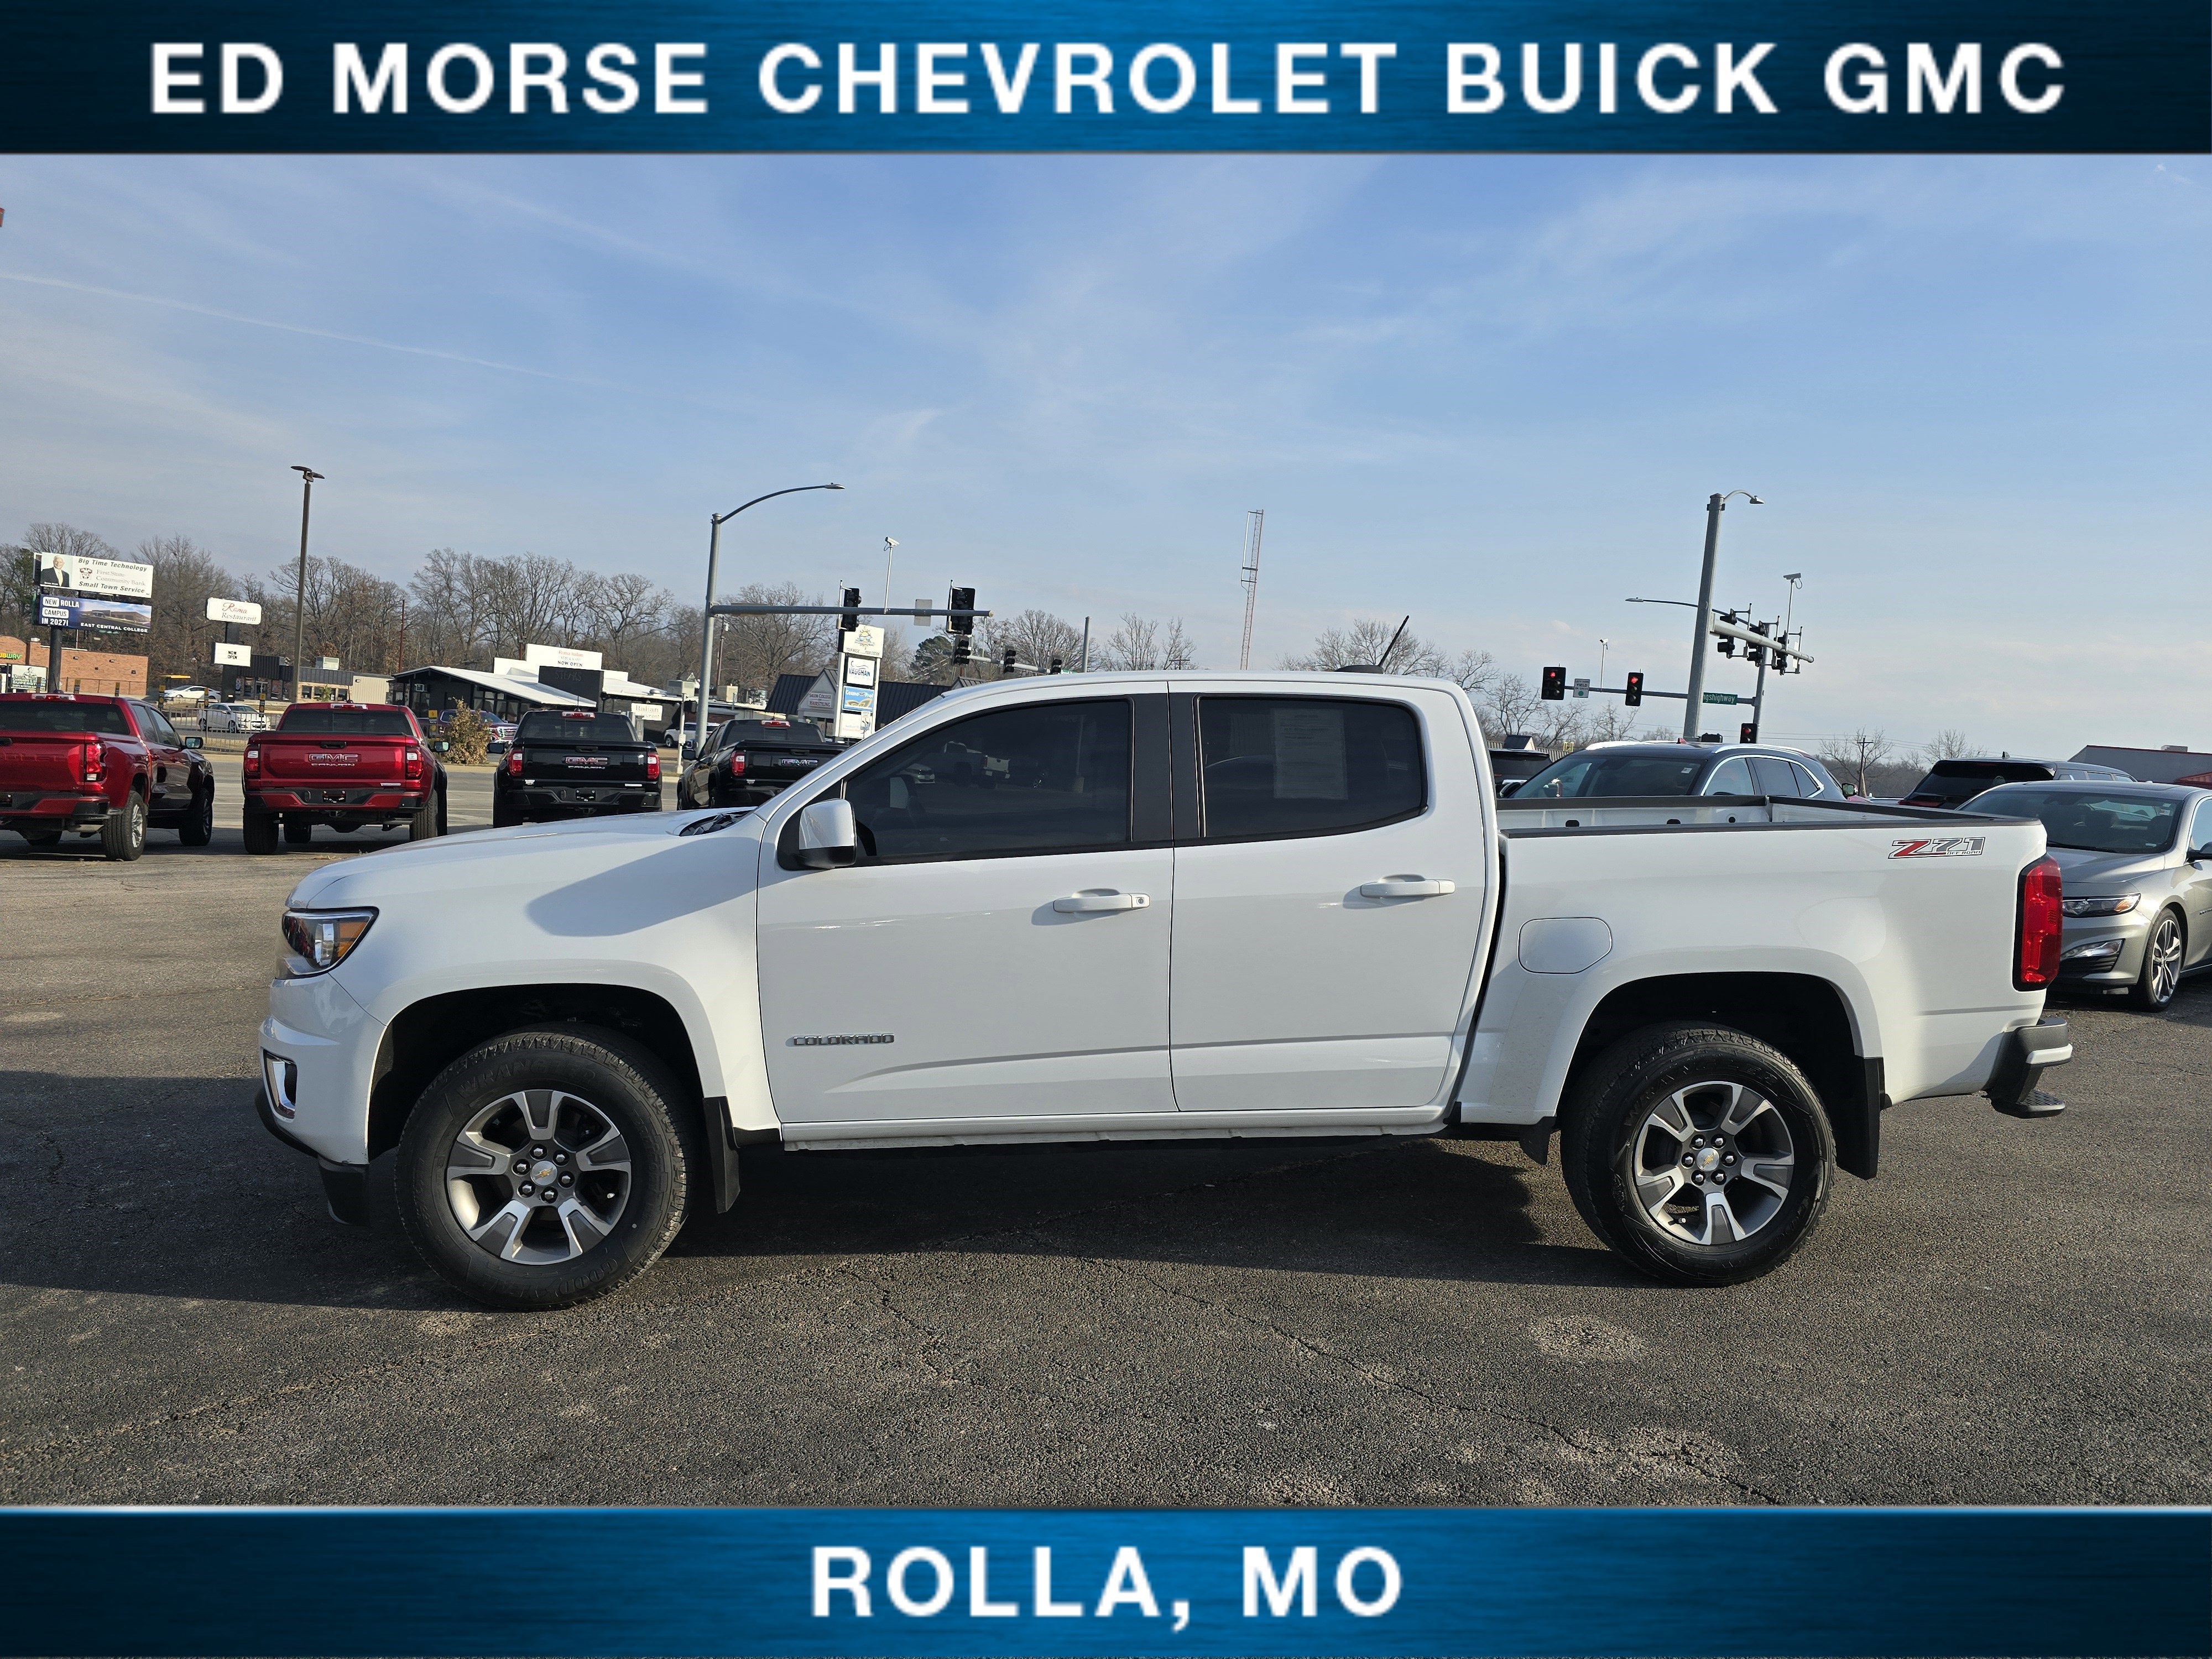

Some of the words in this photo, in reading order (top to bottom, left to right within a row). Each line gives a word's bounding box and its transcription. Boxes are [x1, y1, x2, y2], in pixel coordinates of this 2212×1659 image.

[111, 562, 147, 572] Technology
[222, 612, 257, 621] Restaurant
[849, 668, 870, 676] VAUGHAN
[309, 753, 358, 763] GMC
[565, 757, 608, 765] GMC
[1888, 837, 1986, 859] Z71
[793, 1033, 895, 1046] COLORADO
